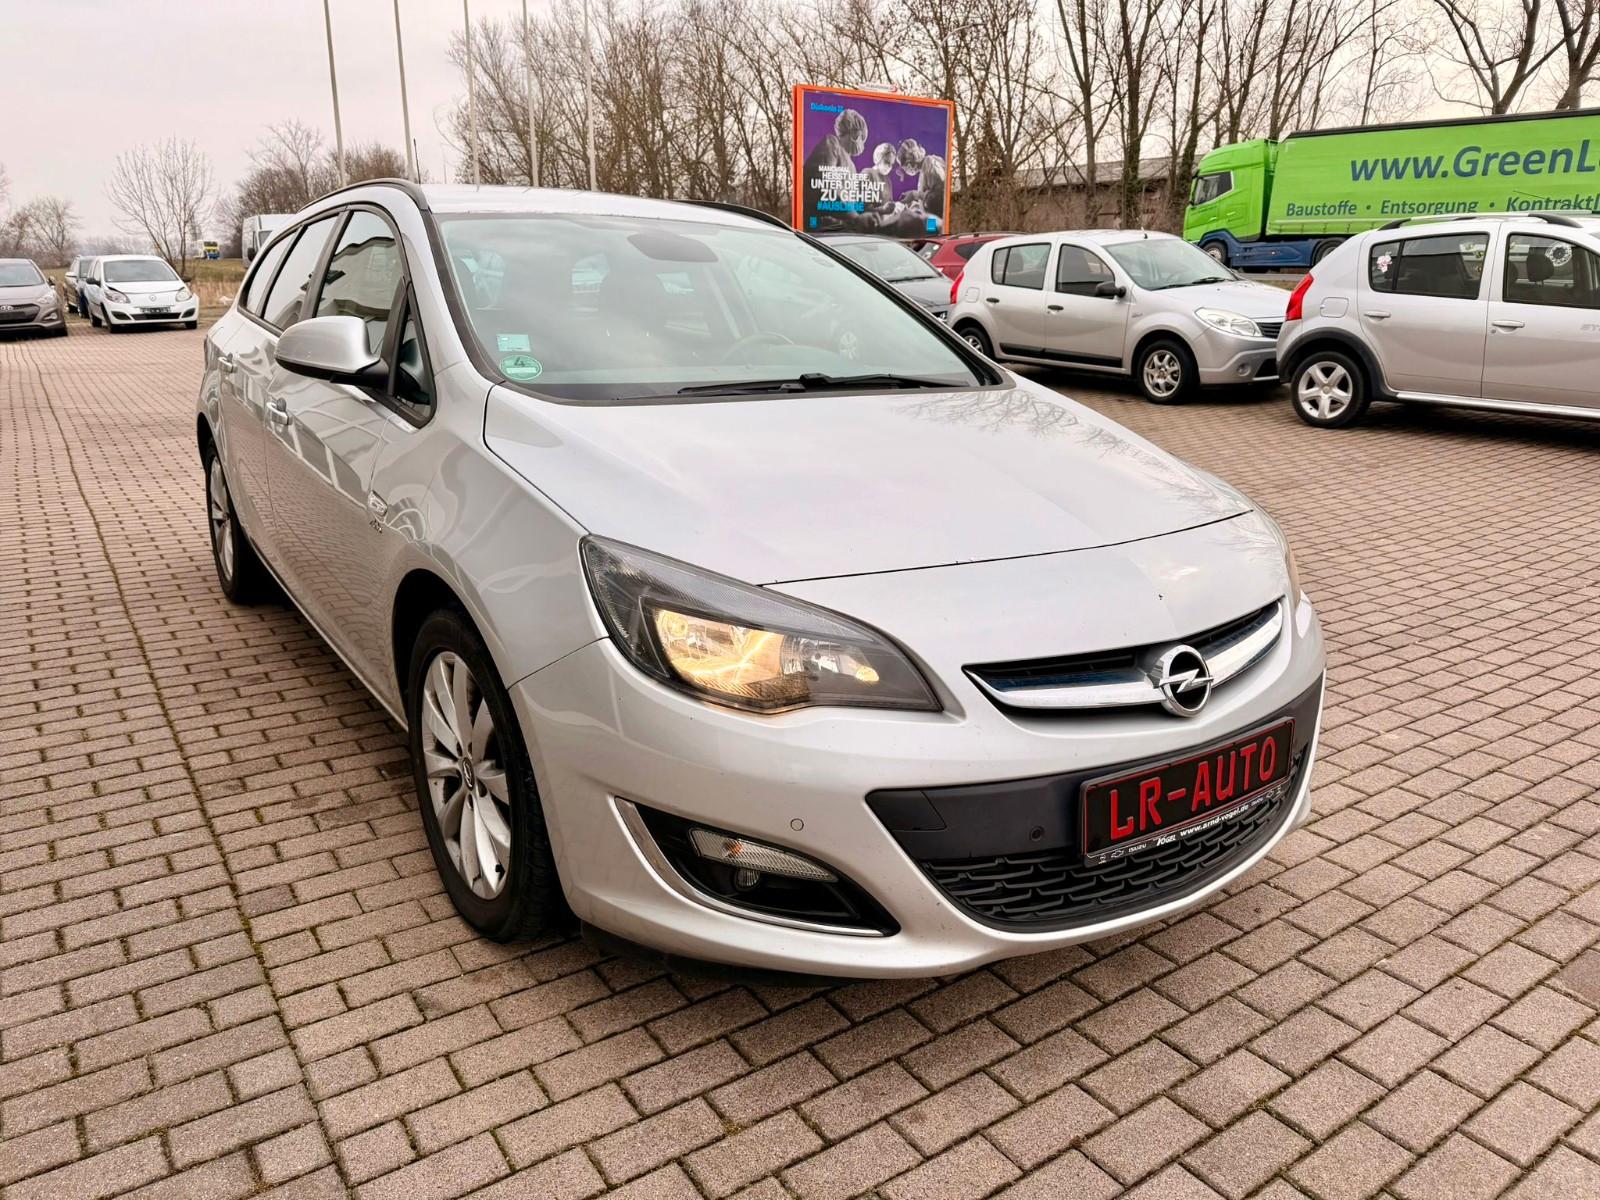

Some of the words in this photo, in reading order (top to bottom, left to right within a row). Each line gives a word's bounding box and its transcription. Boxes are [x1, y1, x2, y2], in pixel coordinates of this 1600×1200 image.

[1351, 139, 1600, 181] www.GreenL
[822, 172, 847, 180] HEISST
[811, 179, 842, 190] UNTER
[844, 181, 860, 191] DIE
[861, 181, 885, 191] HAUT
[820, 189, 838, 201] ZU
[840, 190, 882, 203] GEHEN.
[1286, 201, 1357, 216] Baustoffe
[1380, 200, 1478, 216] Entsorgung
[1110, 736, 1276, 840] LR-AUTO
[1180, 804, 1249, 837] www.arnd-vogel.de
